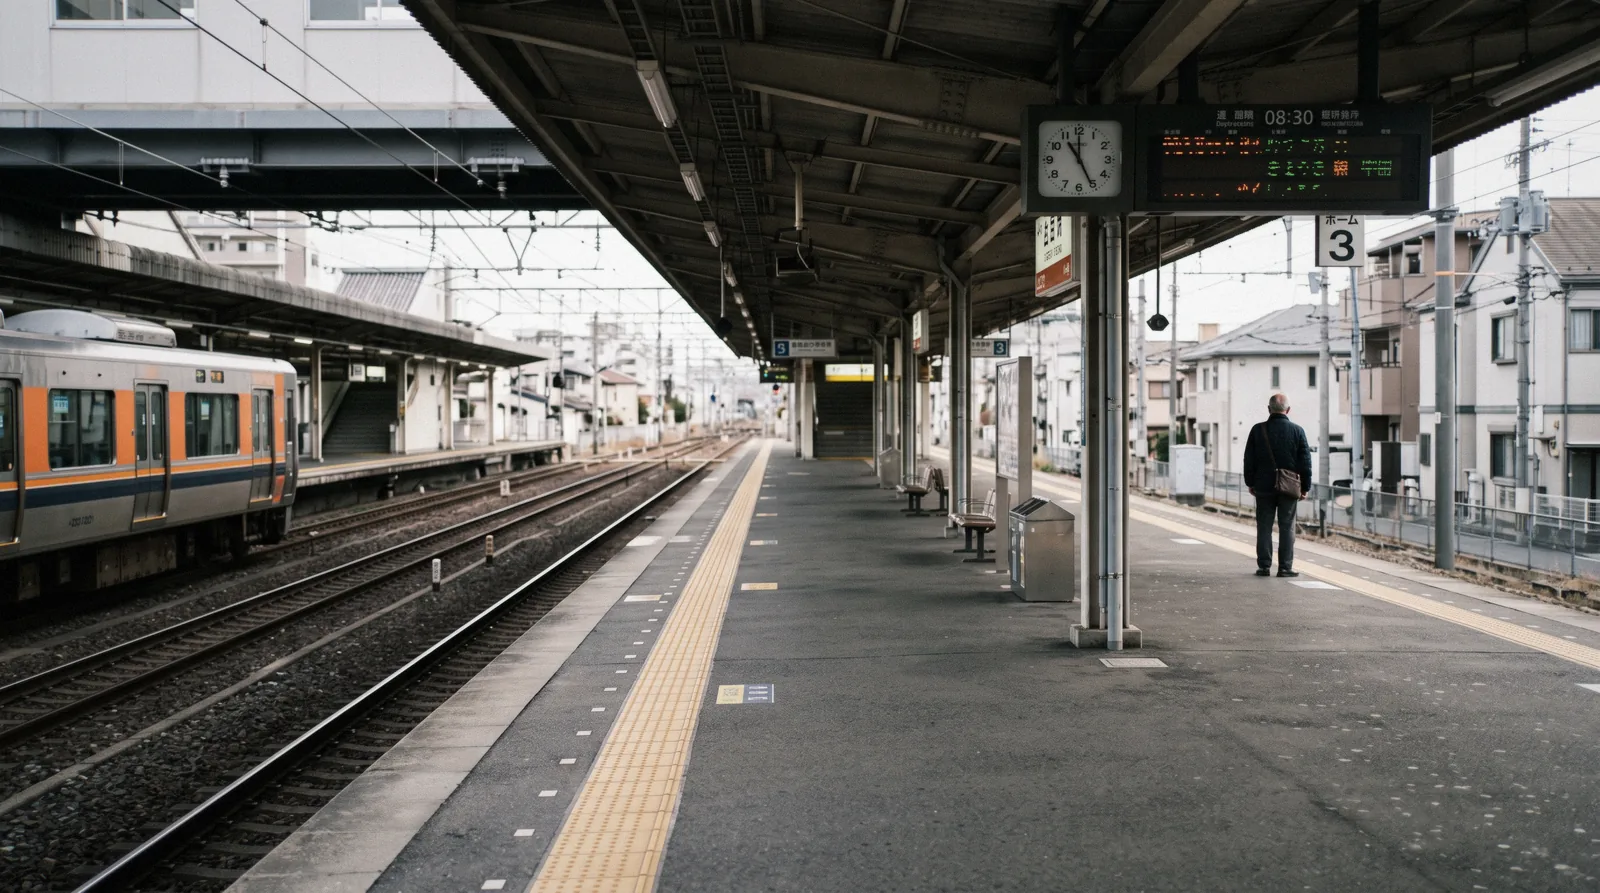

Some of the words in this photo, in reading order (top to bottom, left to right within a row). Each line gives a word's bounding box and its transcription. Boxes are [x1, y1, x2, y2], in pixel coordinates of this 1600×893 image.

[1265, 110, 1313, 125] 08:30
[1074, 127, 1084, 135] 12
[1062, 132, 1069, 140] 11
[1092, 132, 1095, 140] 1
[1052, 142, 1061, 150] 10
[1101, 142, 1108, 150] 2
[1046, 156, 1053, 164] 9
[1104, 156, 1111, 164] 3
[1051, 170, 1058, 178] 8
[1100, 170, 1107, 178] 4
[1062, 180, 1068, 188] 7
[1076, 183, 1082, 192] 6
[1089, 180, 1096, 188] 5
[1325, 214, 1359, 225] ホーム
[1329, 229, 1355, 262] 3
[996, 342, 1005, 354] 3
